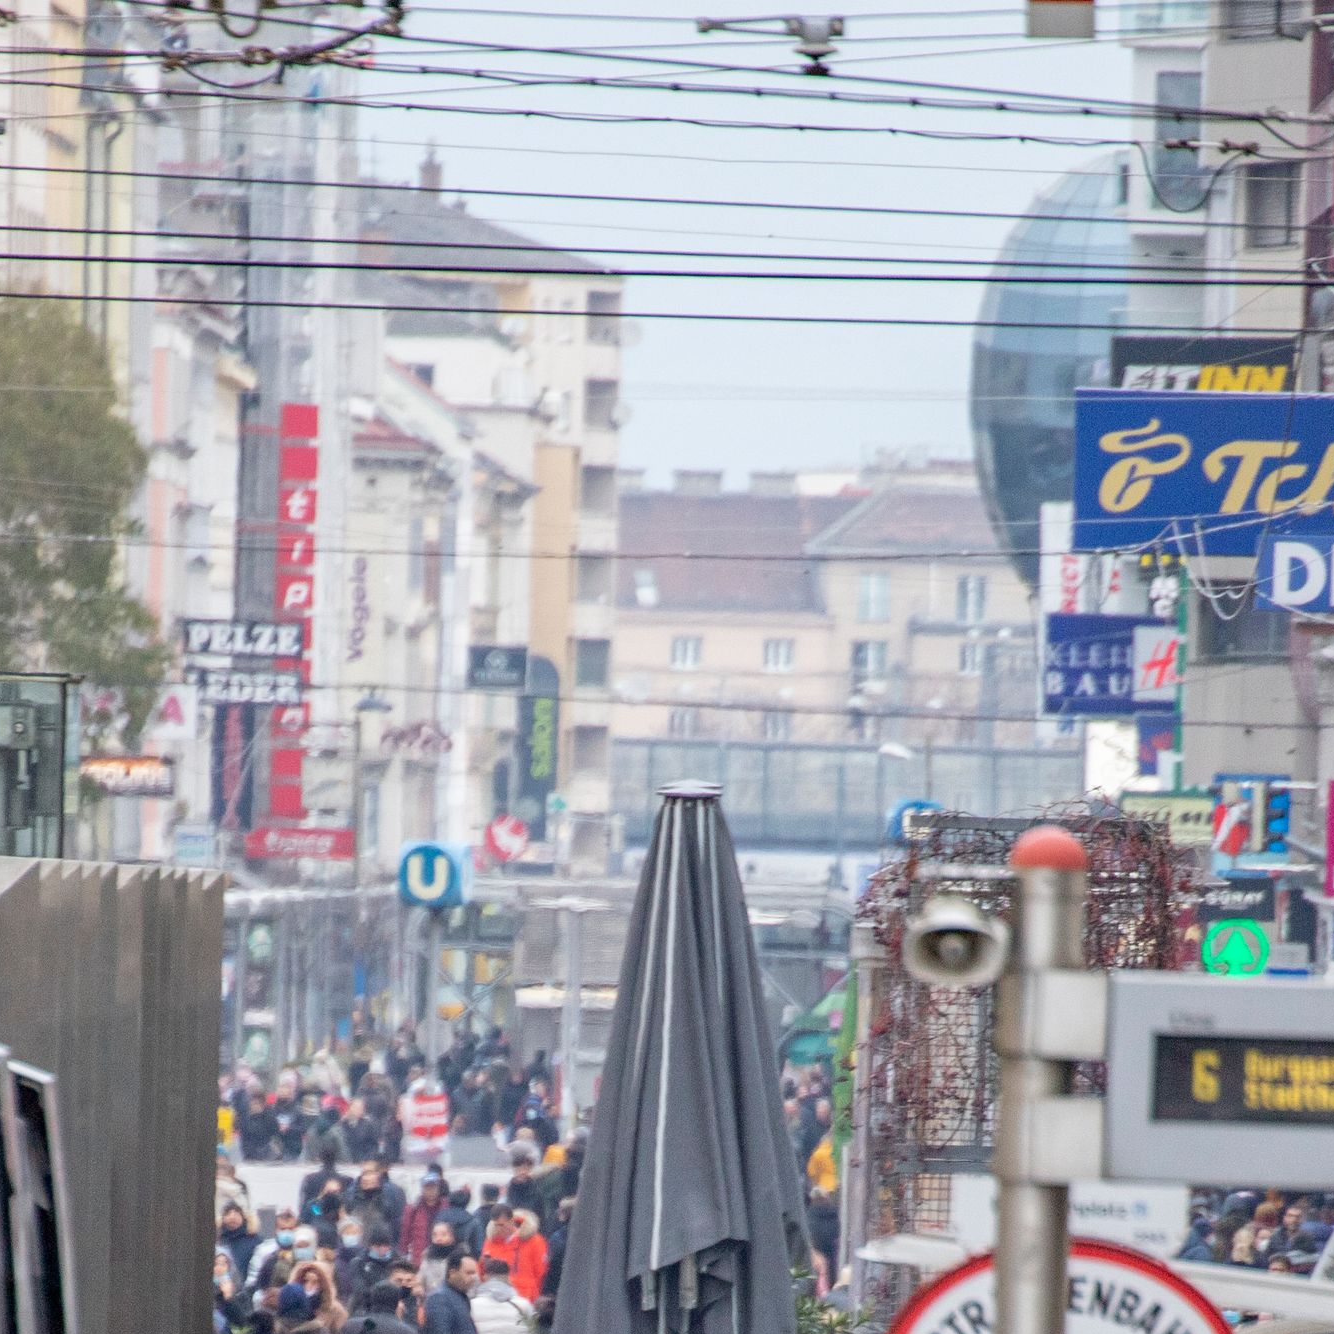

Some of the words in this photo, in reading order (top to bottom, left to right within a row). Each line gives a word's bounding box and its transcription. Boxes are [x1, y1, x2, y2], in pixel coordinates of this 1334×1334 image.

[188, 622, 301, 654] PELZE
[407, 853, 448, 901] U
[1191, 1048, 1221, 1103] 6
